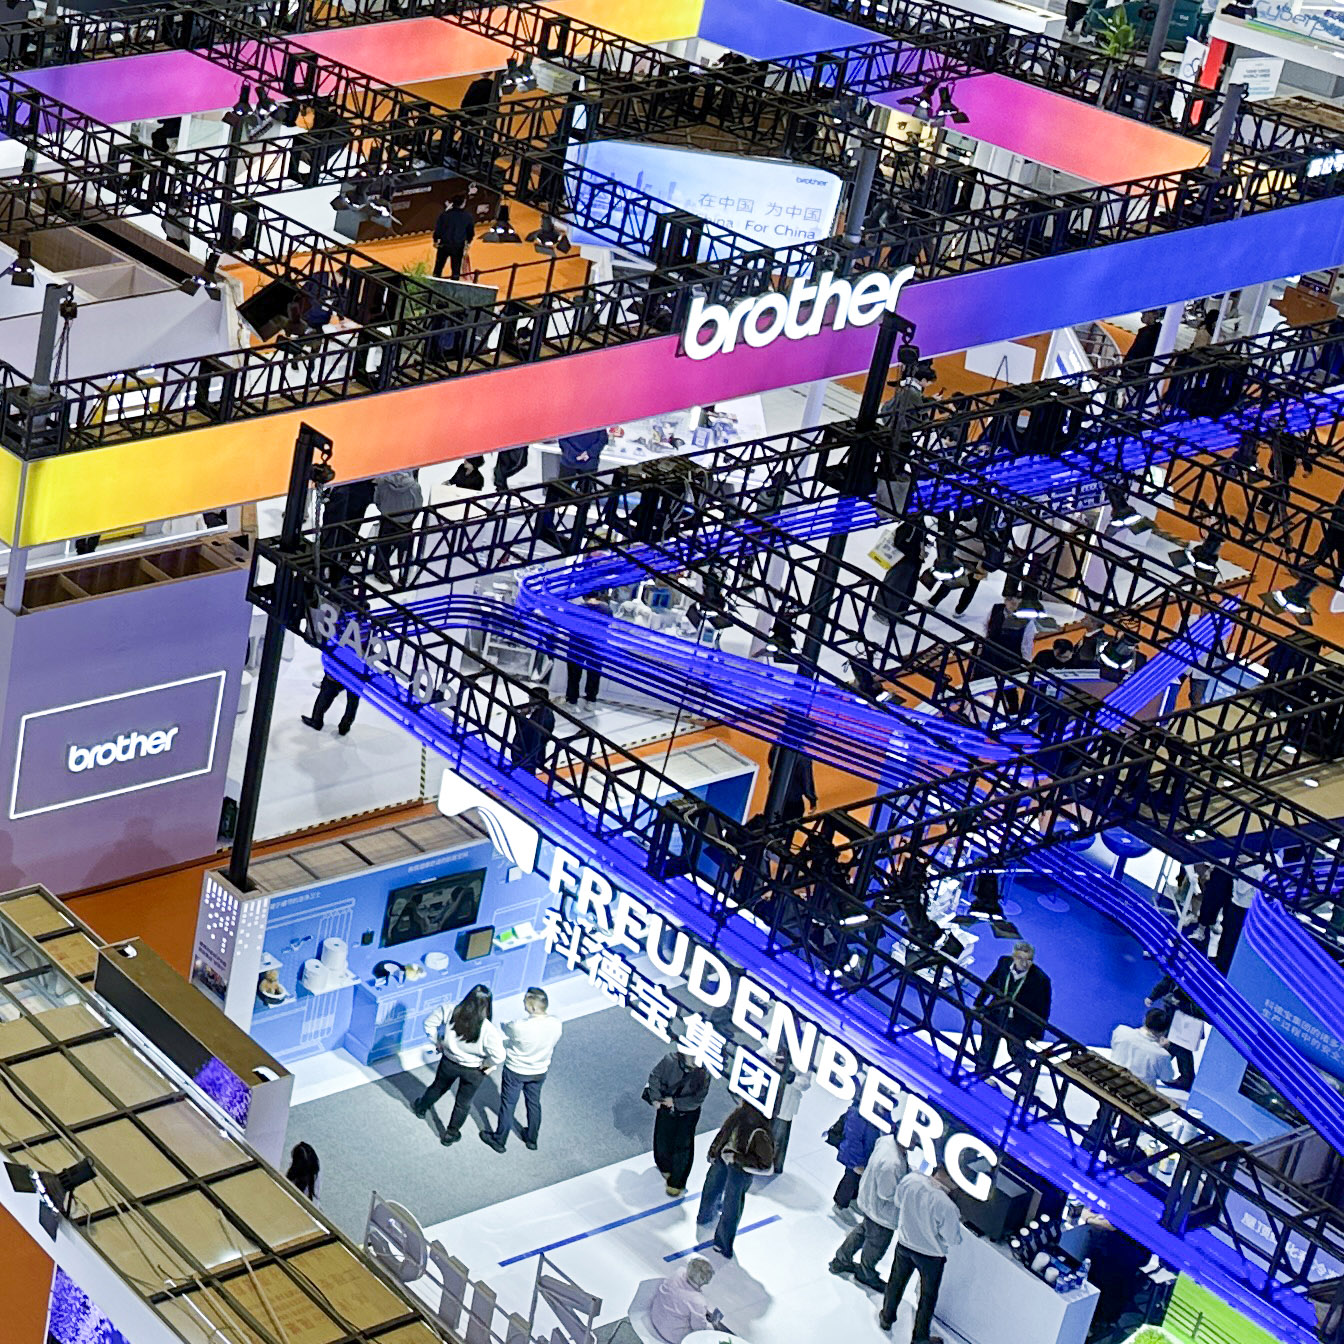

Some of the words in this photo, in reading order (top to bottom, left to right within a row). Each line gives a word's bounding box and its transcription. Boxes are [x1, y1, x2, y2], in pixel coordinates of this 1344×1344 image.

[796, 175, 829, 188] brother
[698, 191, 755, 215] 在中国
[766, 199, 823, 225] 为中国
[744, 219, 768, 235] For
[772, 223, 817, 241] China
[681, 264, 916, 363] brother
[67, 725, 179, 775] brother
[542, 906, 783, 1121] 科德宝集团
[548, 853, 998, 1203] FREUDENBERG
